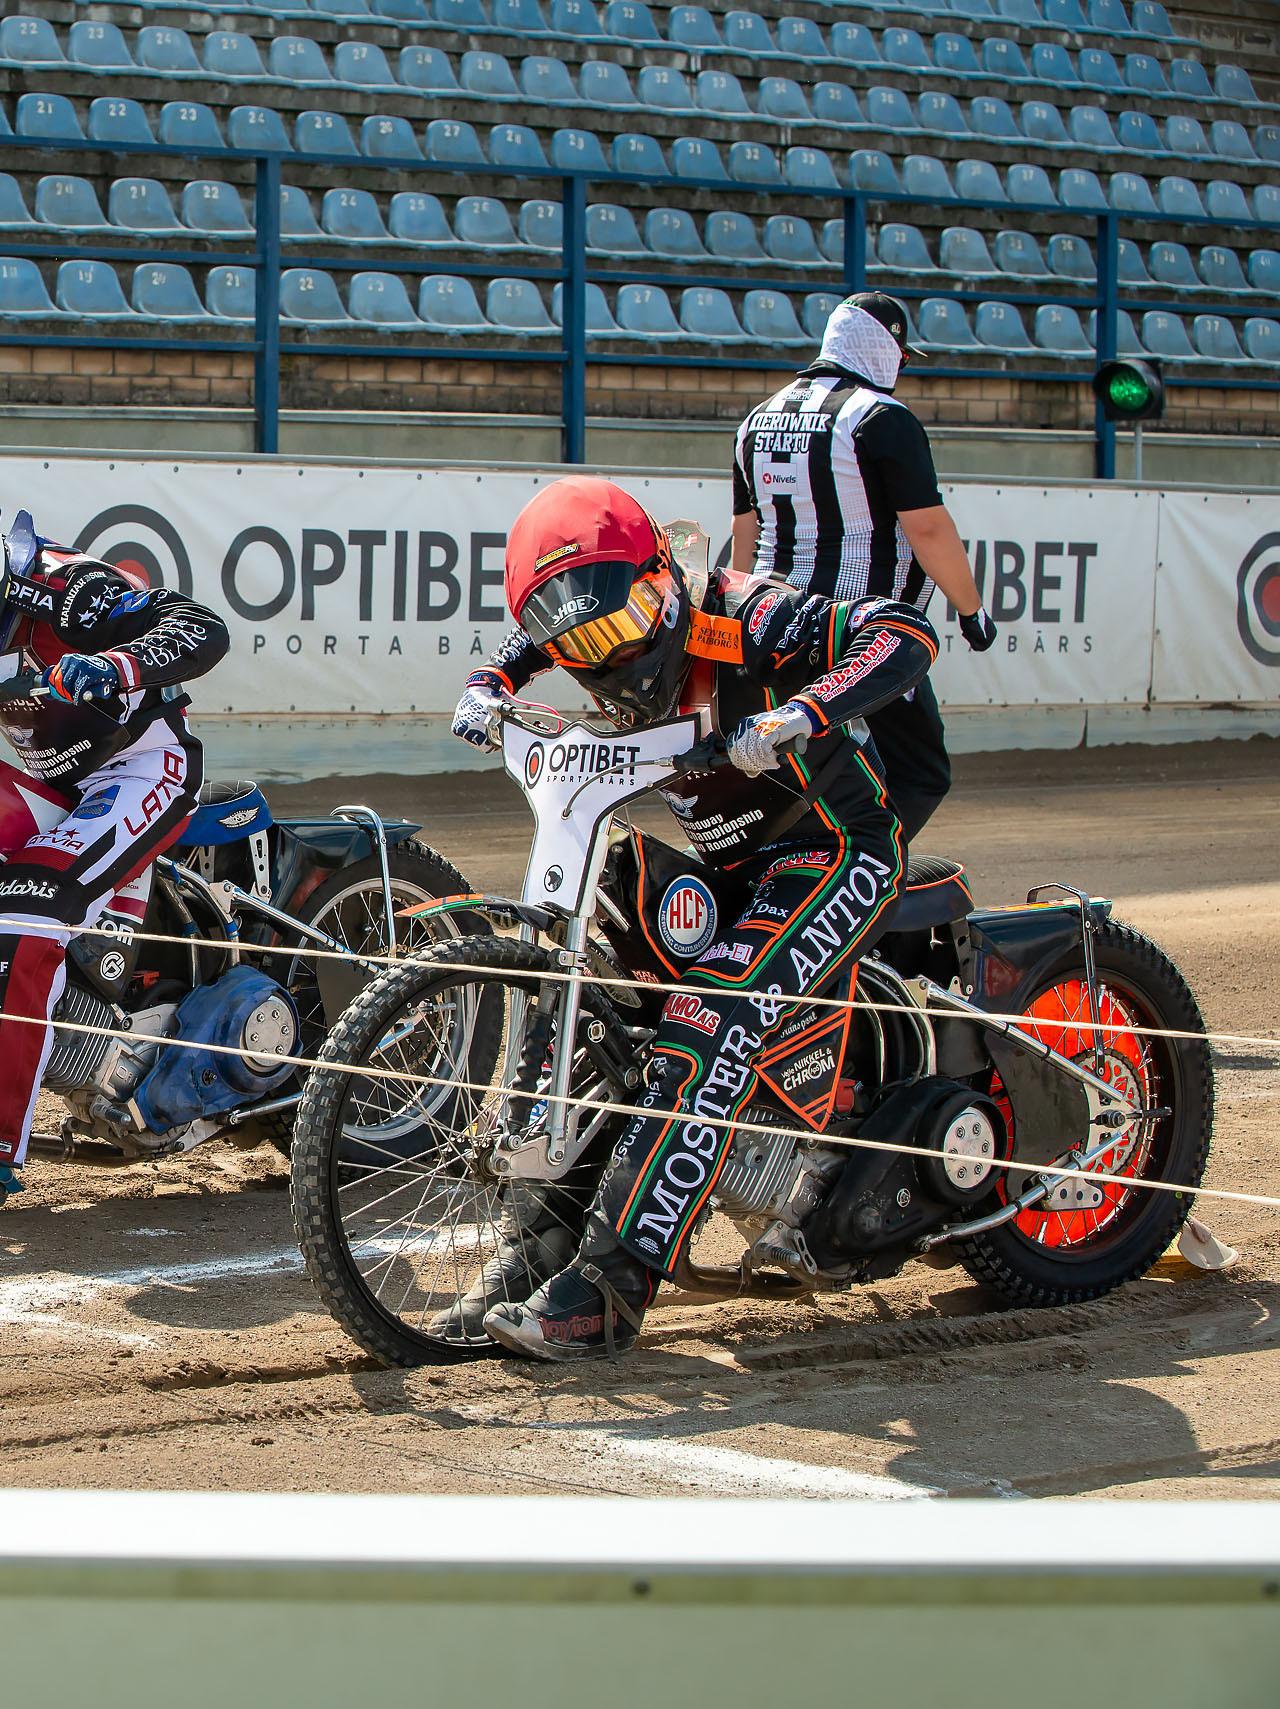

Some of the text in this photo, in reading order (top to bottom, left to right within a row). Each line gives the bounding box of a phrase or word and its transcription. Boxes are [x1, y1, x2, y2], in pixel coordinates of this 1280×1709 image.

[20, 21, 37, 34] 22
[87, 26, 104, 38] 23
[156, 31, 171, 44] 24
[37, 100, 52, 113] 21
[109, 103, 126, 115] 22
[180, 107, 196, 120] 23
[248, 110, 264, 123] 24
[314, 115, 332, 128] 25
[444, 124, 460, 136] 27
[130, 184, 145, 198] 21
[203, 185, 218, 198] 22
[340, 193, 356, 206] 24
[537, 205, 554, 218] 27
[225, 272, 239, 286] 21
[299, 276, 313, 290] 22
[748, 412, 832, 432] KIEROWNIK
[754, 432, 812, 453] STARTU
[773, 474, 797, 484] Nivels
[221, 526, 507, 622] OPTIBE
[253, 634, 403, 655] PORTA
[1007, 630, 1093, 653] BĀRS
[549, 744, 641, 776] OPTIBET
[28, 835, 86, 852] ATVIA
[706, 833, 741, 852] Round
[669, 888, 706, 930] HCF
[756, 902, 789, 919] Dax
[793, 1050, 826, 1073] NIKKEL
[637, 1024, 762, 1244] MOSTER
[749, 983, 787, 1028] &
